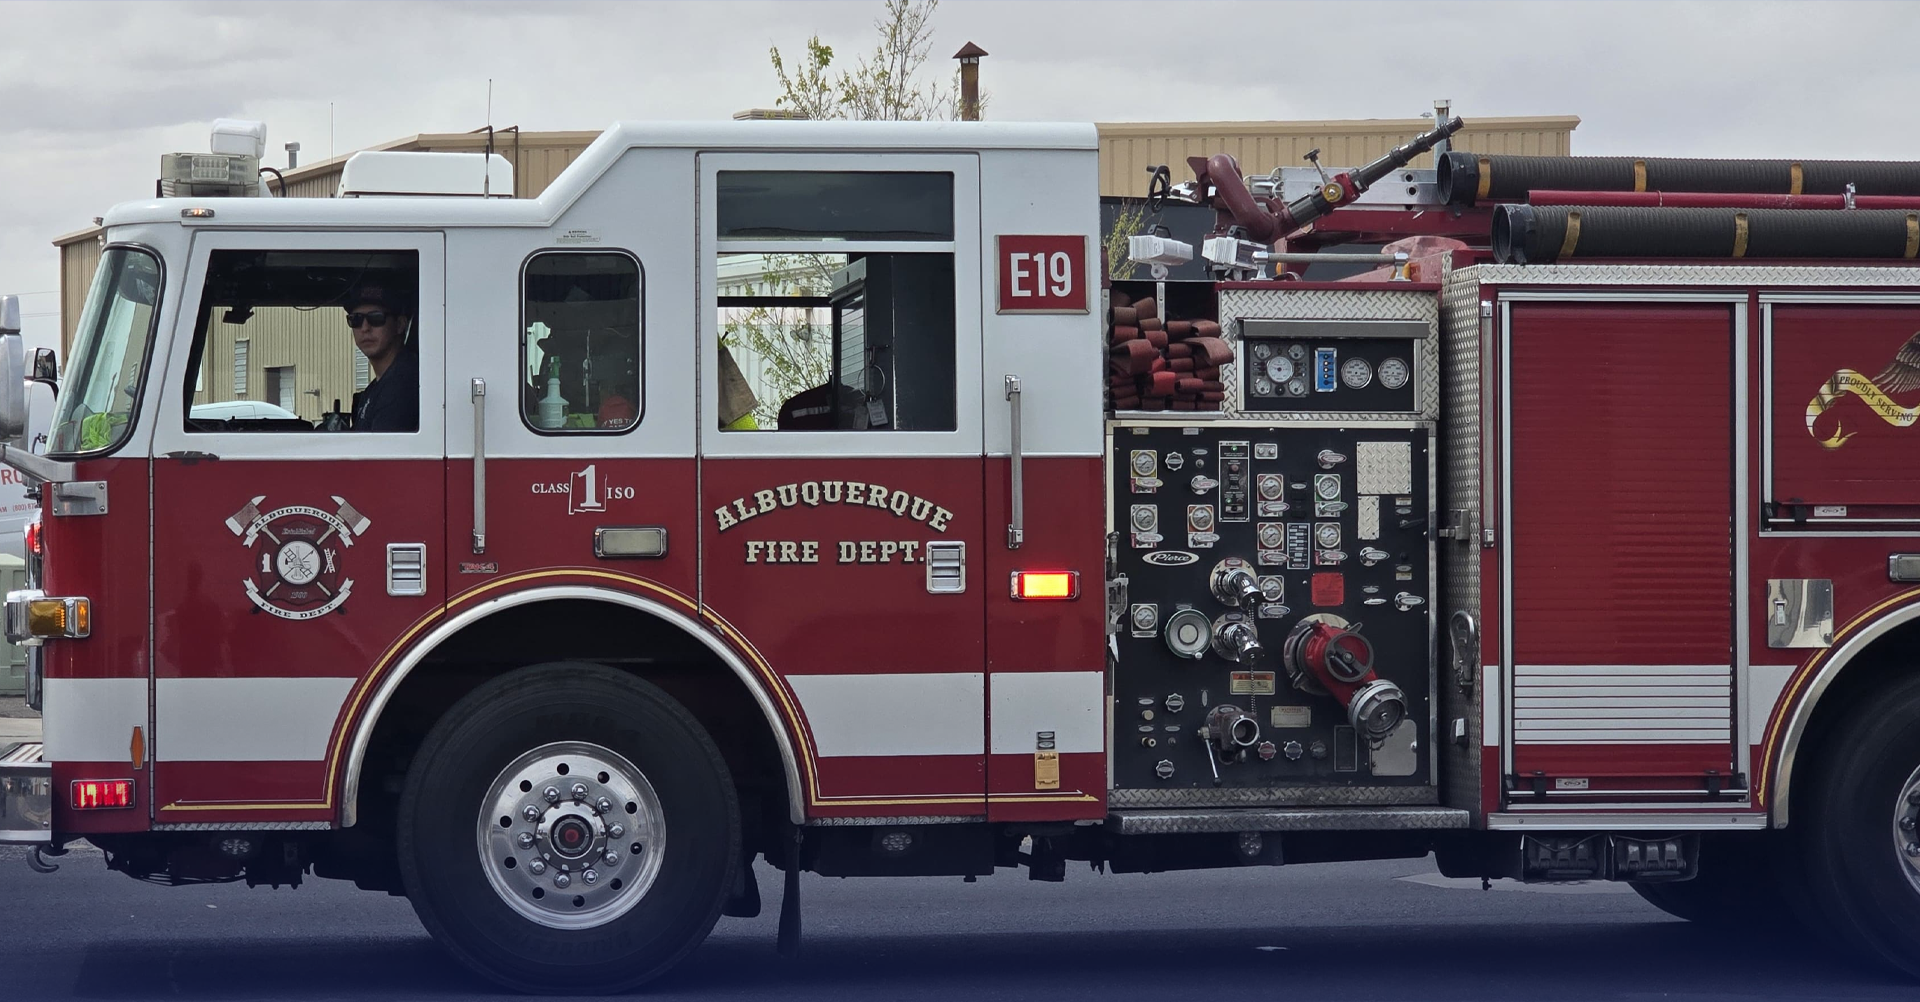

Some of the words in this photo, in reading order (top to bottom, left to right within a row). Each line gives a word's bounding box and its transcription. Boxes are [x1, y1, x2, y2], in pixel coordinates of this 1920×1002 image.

[1010, 251, 1073, 298] E19
[1839, 376, 1876, 400] PROUDLY
[1876, 398, 1914, 422] SERVING
[531, 483, 570, 494] CLASS
[578, 464, 602, 508] 1
[606, 487, 635, 499] ISO
[254, 507, 344, 530] ALBUQUERQUE
[714, 480, 953, 533] ALBUQUERQUE
[745, 540, 820, 564] FIRE
[838, 540, 926, 564] DEPT.
[1153, 553, 1190, 562] Pierce
[261, 602, 292, 618] FIRE
[299, 603, 337, 618] DEPT.
